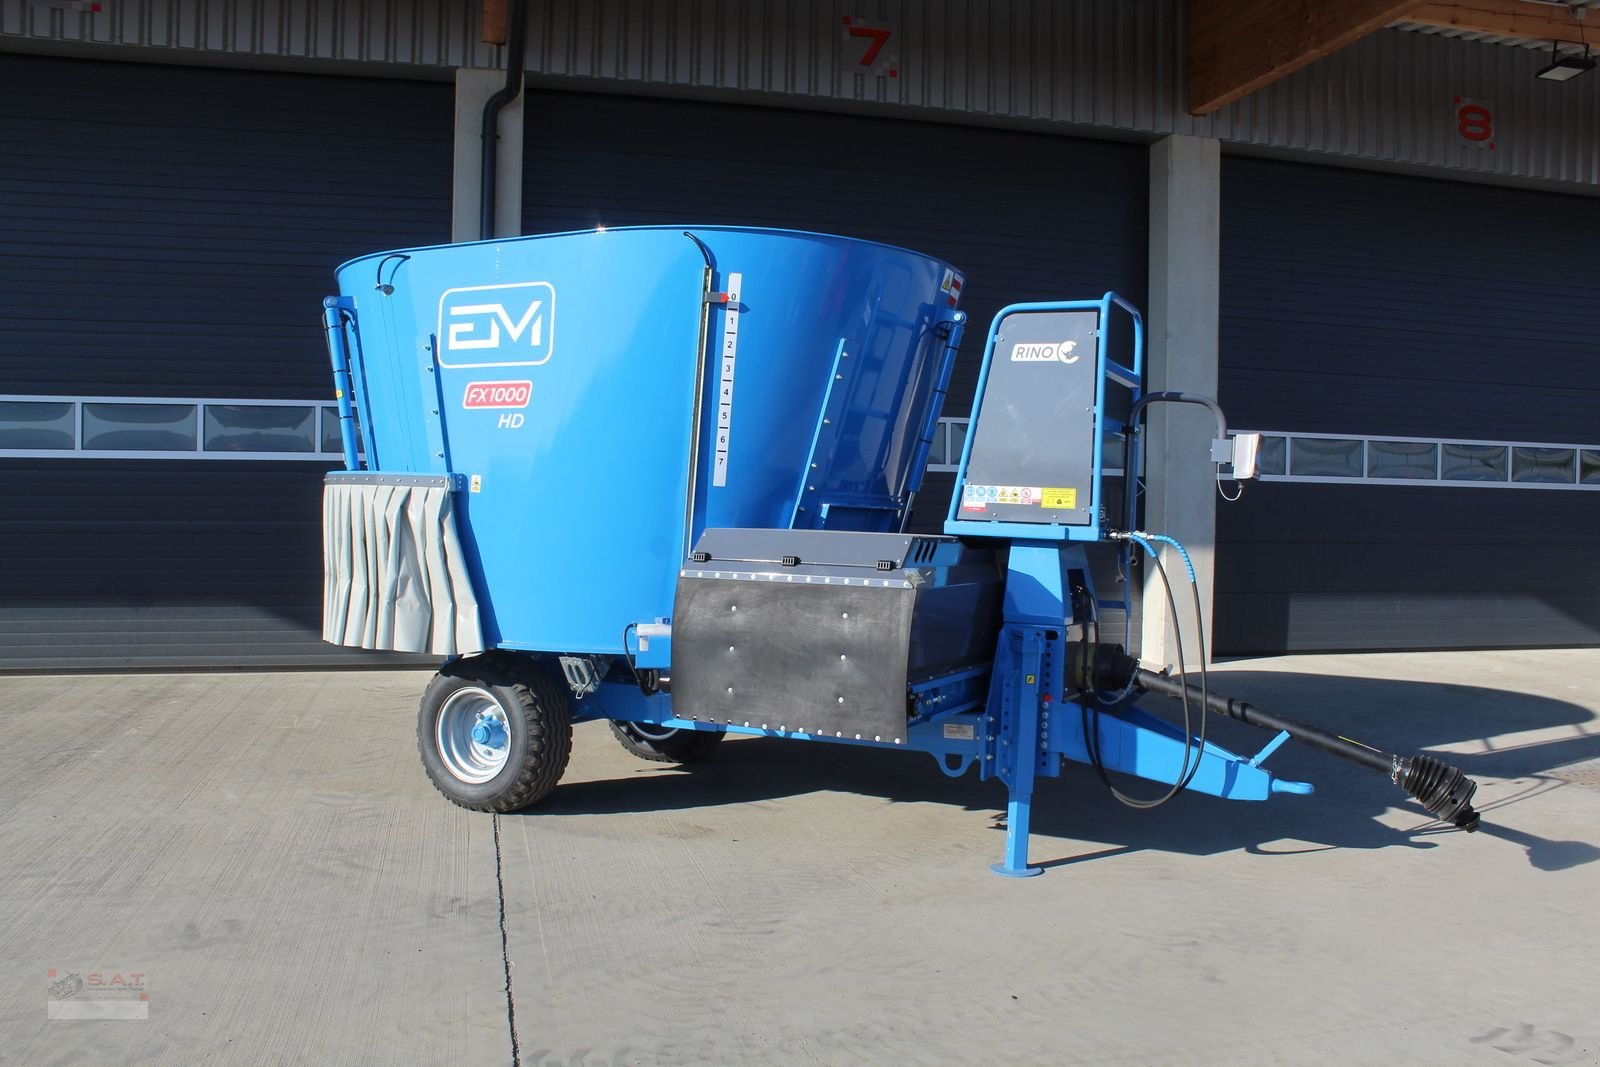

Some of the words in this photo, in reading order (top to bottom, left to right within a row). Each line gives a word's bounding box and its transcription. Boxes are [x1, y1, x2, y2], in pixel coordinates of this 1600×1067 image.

[849, 26, 892, 66] 7
[1458, 104, 1492, 142] 8
[731, 293, 737, 301] 0
[448, 300, 543, 350] EM
[729, 317, 734, 325] 1
[727, 341, 733, 349] 2
[1015, 346, 1054, 359] RINO
[725, 364, 731, 373] 3
[467, 386, 527, 404] FX1000
[723, 388, 729, 396] 4
[722, 411, 728, 420] 5
[497, 413, 525, 429] HD
[720, 435, 726, 444] 6
[719, 457, 724, 466] 7
